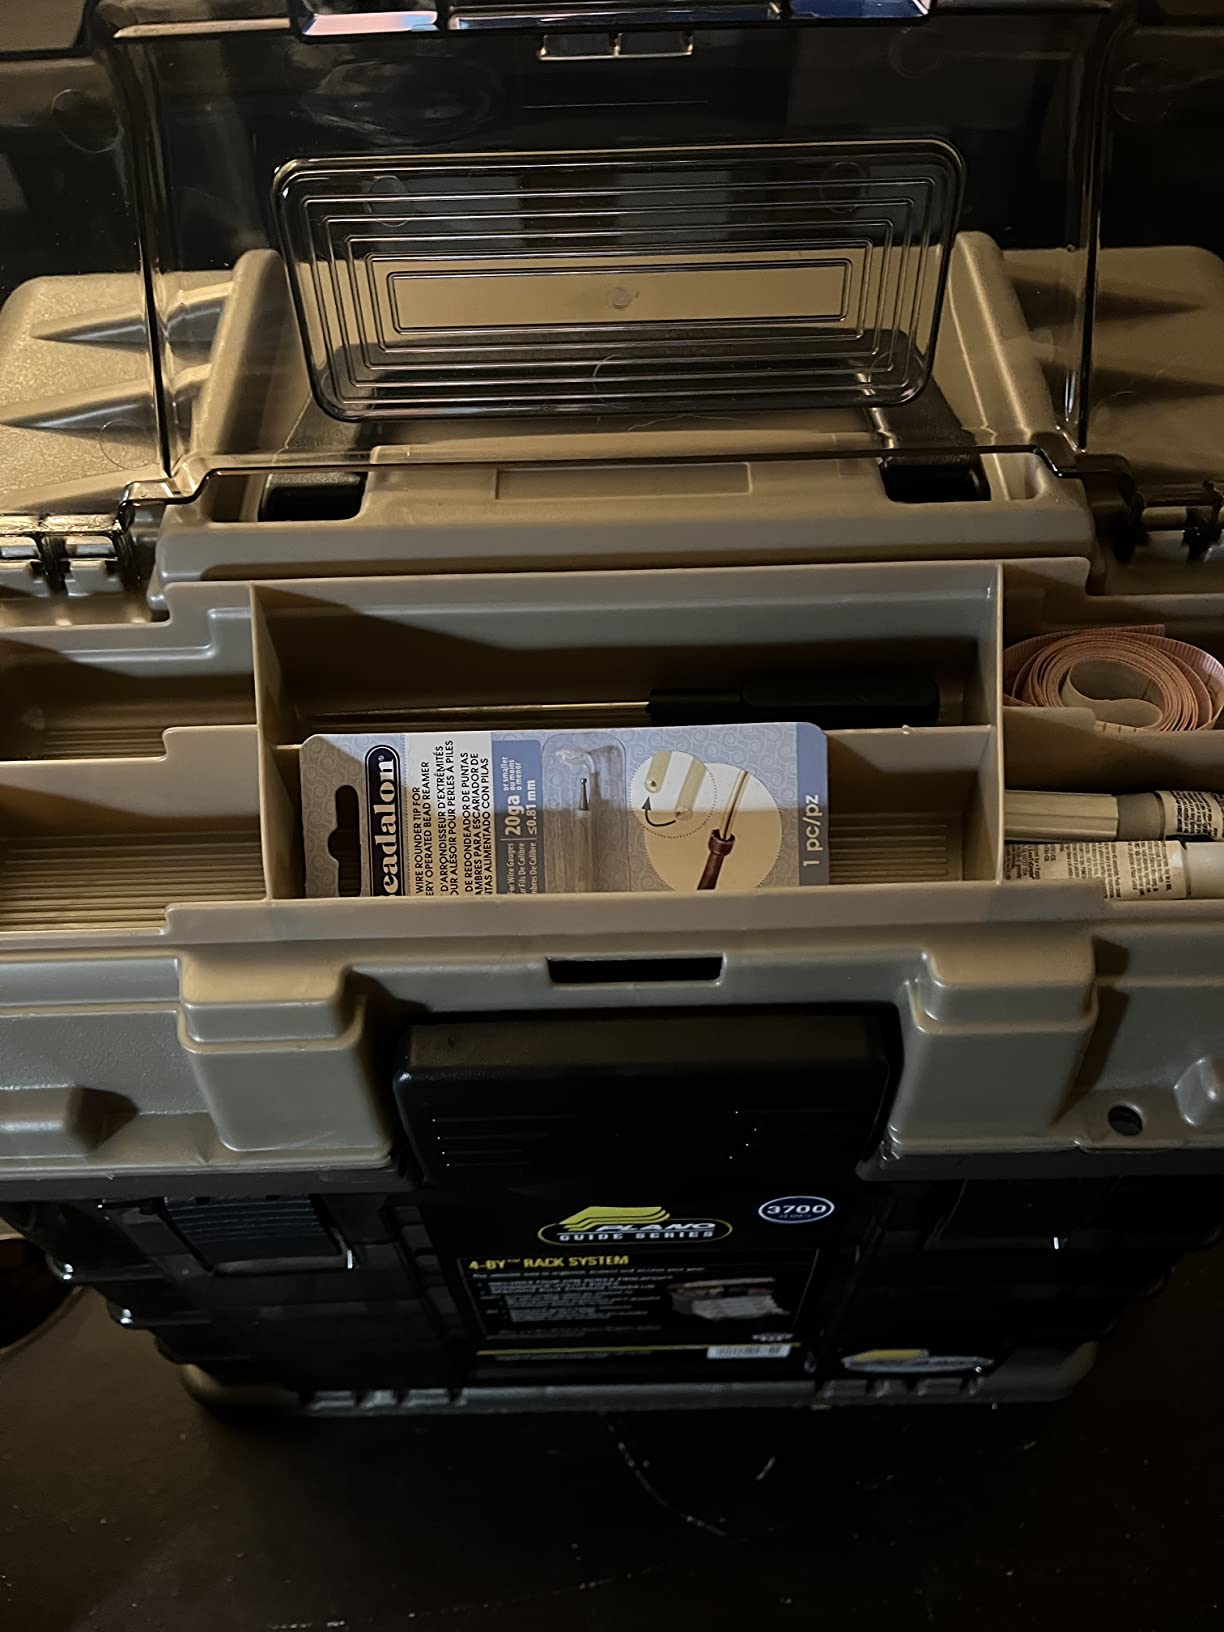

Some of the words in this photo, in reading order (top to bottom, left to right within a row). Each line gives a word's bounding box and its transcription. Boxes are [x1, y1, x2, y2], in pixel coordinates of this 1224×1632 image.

[445, 740, 453, 763] PILES
[470, 753, 478, 765] DE
[421, 762, 430, 800] REAMER
[433, 746, 446, 809] D'EXTRÉMITÉS
[460, 753, 469, 787] PUNTAS
[480, 758, 489, 783] PILAS
[500, 757, 509, 782] smaller
[514, 762, 522, 785] menor
[412, 787, 421, 805] FOR
[446, 775, 455, 806] PERLES
[461, 790, 469, 802] DE
[481, 786, 490, 809] CON
[510, 782, 515, 790] ou
[526, 780, 536, 801] mm
[470, 768, 481, 829] ESCARIADOR
[413, 809, 421, 820] TIP
[422, 803, 431, 827] BEAD
[448, 809, 456, 834] POUR
[504, 795, 524, 835] 20ga
[802, 794, 823, 852] pc/pz
[373, 759, 398, 896] eadalon
[414, 823, 422, 868] ROUNDER
[438, 812, 448, 892] D'ARRONDISSEUR
[462, 805, 472, 878] REDONDEADOR
[472, 832, 481, 856] PARA
[482, 811, 492, 872] ALIMENTADO
[423, 830, 433, 877] OPERATED
[446, 837, 458, 875] ALÉSOIR
[506, 843, 515, 866] Gauges
[517, 843, 526, 865] Calibre
[529, 843, 537, 865] Calibre
[518, 866, 525, 875] De
[529, 866, 537, 874] De
[415, 871, 423, 893] WIRE
[464, 880, 473, 892] DE
[766, 1204, 828, 1215] 3700
[559, 1233, 625, 1242] GUIDE
[635, 1231, 714, 1239] SERIES
[523, 1257, 565, 1268] RACK
[568, 1255, 630, 1266] SYSTEM
